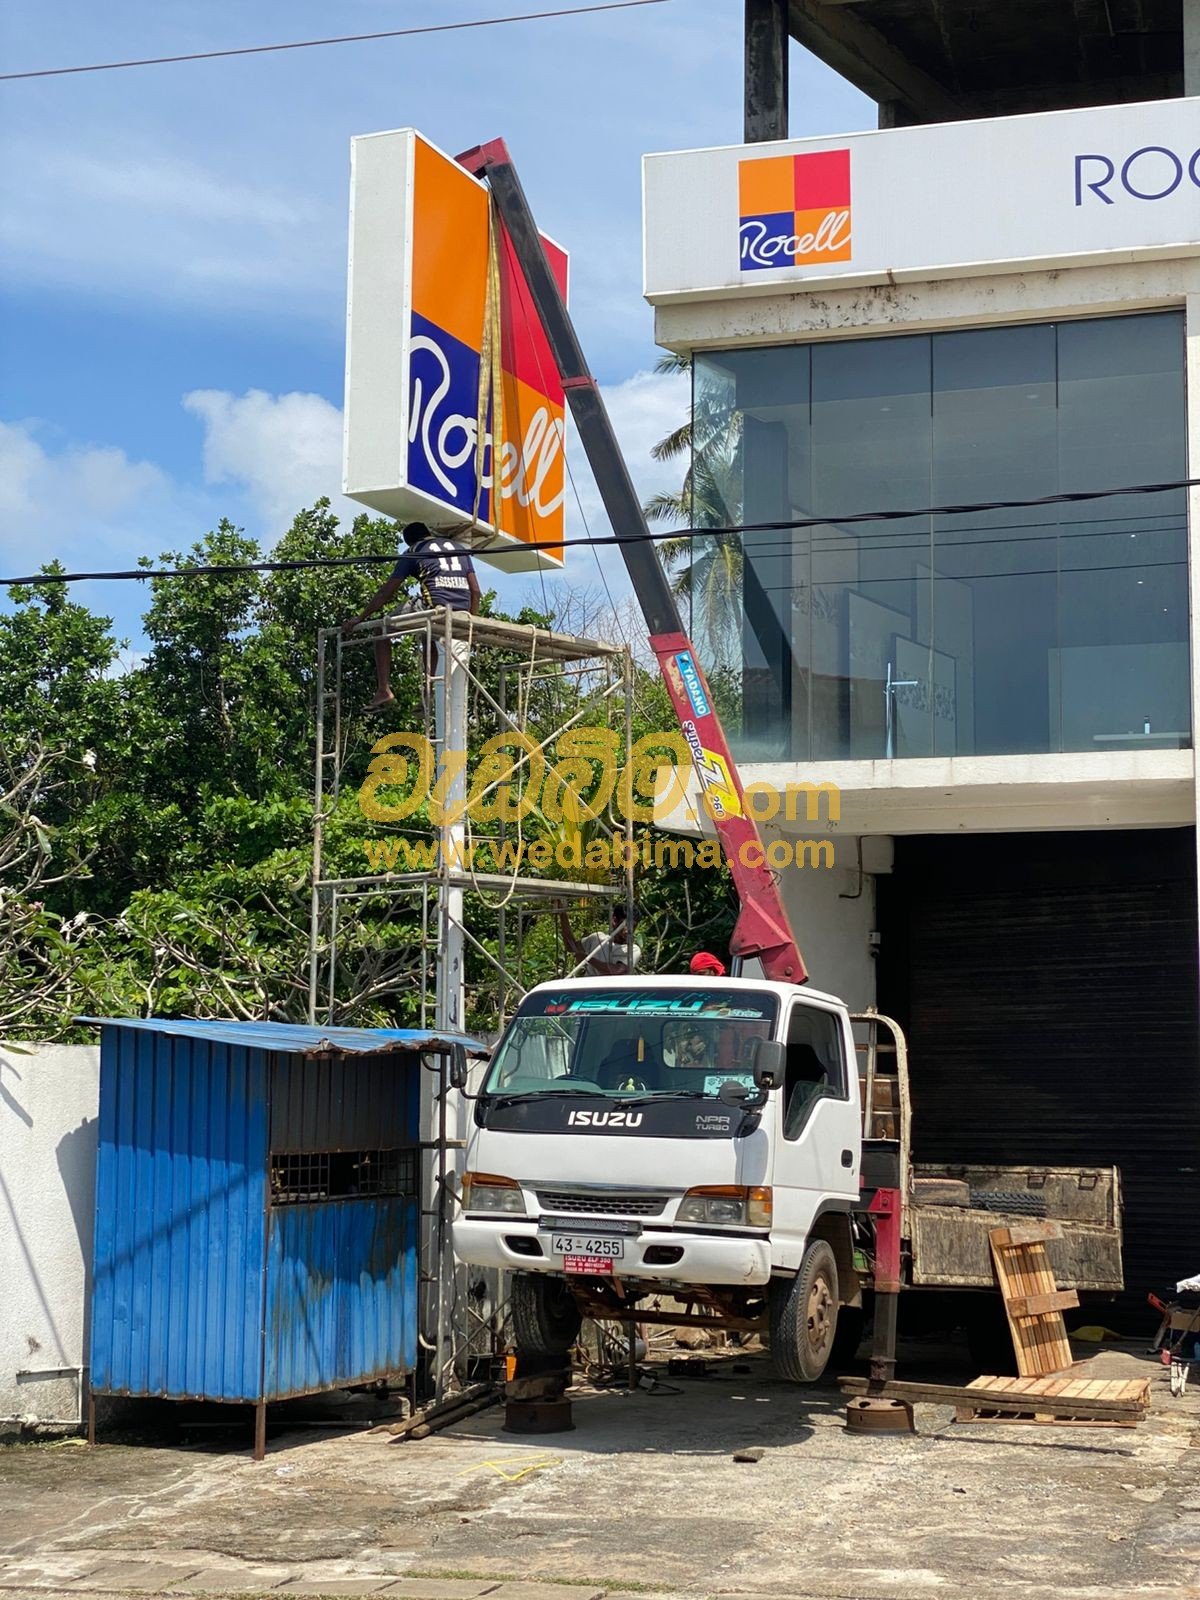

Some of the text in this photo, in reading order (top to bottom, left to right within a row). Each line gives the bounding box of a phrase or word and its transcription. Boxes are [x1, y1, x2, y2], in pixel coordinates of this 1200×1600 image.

[1074, 145, 1200, 207] RO
[738, 209, 852, 266] Rocell
[429, 541, 462, 572] 11
[682, 667, 708, 716] TADANO
[568, 1000, 705, 1012] ISUZU
[568, 1110, 643, 1128] ISUZU
[695, 1114, 731, 1125] NPR
[695, 1123, 730, 1131] TURBO
